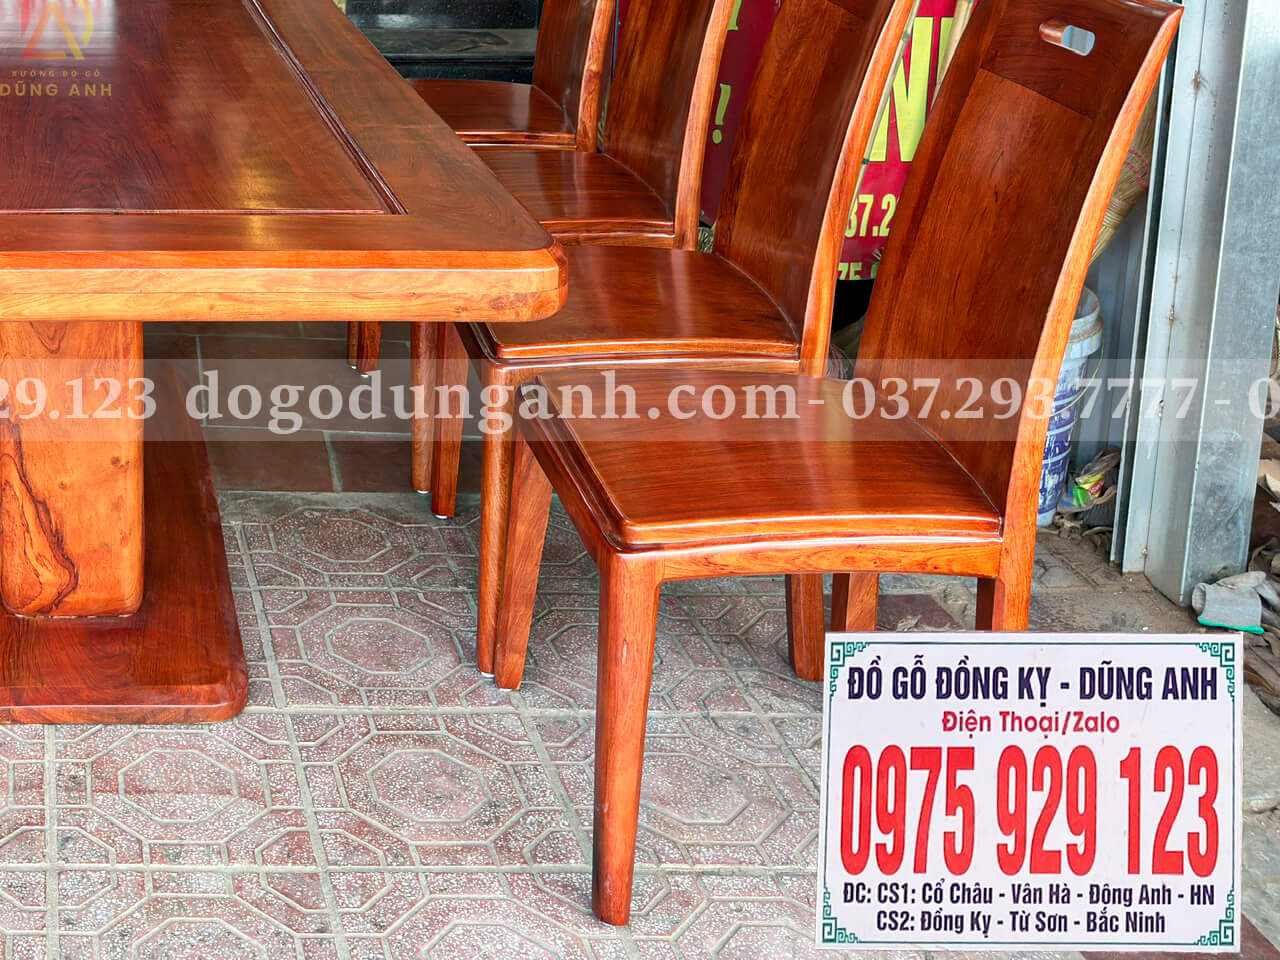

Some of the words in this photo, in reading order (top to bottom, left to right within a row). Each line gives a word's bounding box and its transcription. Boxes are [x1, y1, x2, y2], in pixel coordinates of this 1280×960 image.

[847, 656, 883, 700] ĐỒ
[892, 655, 928, 700] GỖ
[935, 656, 1009, 700] ĐỒNG
[1019, 666, 1052, 708] KỴ
[1079, 659, 1153, 700] DŨNG
[1162, 667, 1218, 700] ANH
[942, 710, 992, 739] Điện
[999, 710, 1120, 740] Thoại/Zalo
[840, 744, 976, 876] 0975
[996, 744, 1098, 877] 929
[1120, 744, 1219, 878] 123
[843, 883, 872, 904] ĐC:
[877, 883, 915, 904] CS1:
[921, 878, 944, 904] Cổ
[949, 883, 993, 905] Châu
[1011, 884, 1043, 905] Vân
[1049, 884, 1071, 905] Hà
[1089, 883, 1133, 908] Đông
[1138, 883, 1172, 905] Anh
[1190, 885, 1215, 905] HN
[876, 910, 915, 932] CS2:
[920, 907, 965, 934] Đồng
[970, 911, 992, 938] Kỵ
[1009, 909, 1030, 933] Từ
[1035, 910, 1068, 933] Sơn
[1086, 907, 1119, 933] Bắc
[1125, 910, 1166, 933] Ninh
